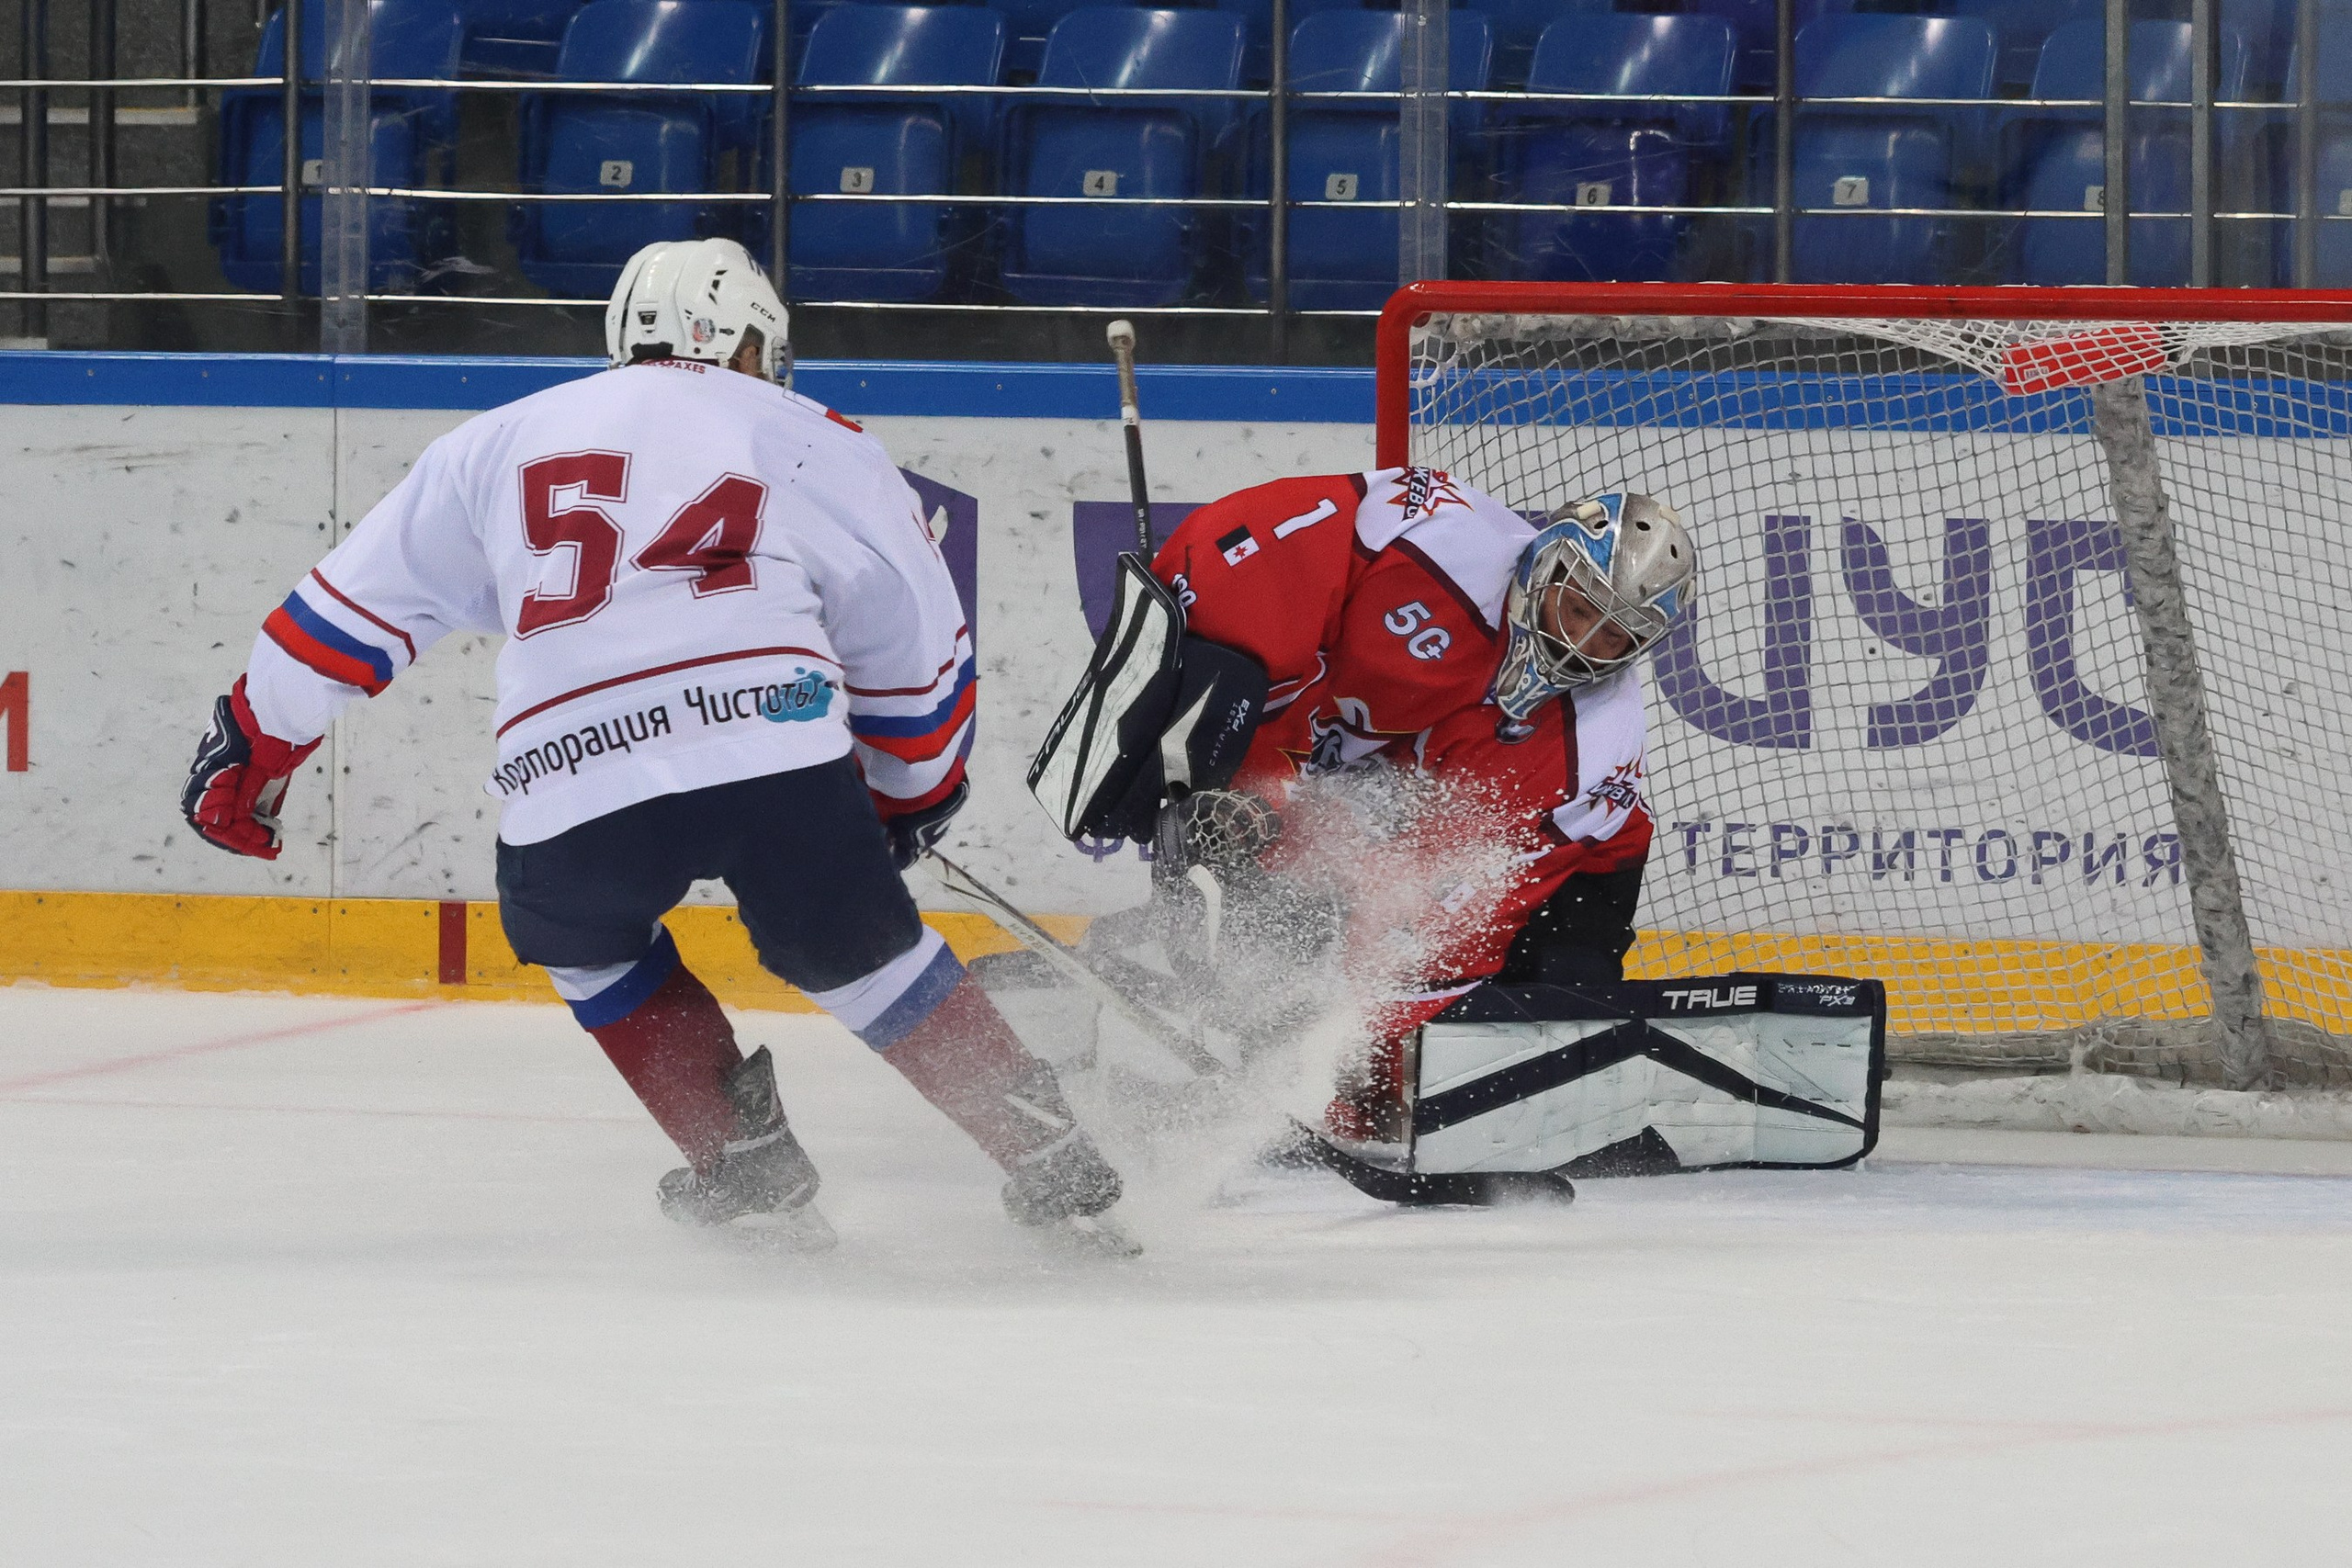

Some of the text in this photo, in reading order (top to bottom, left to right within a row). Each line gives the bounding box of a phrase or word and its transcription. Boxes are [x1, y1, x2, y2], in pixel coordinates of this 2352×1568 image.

[611, 165, 623, 181] 2
[851, 171, 863, 188] 3
[1093, 175, 1105, 191] 4
[1335, 179, 1348, 196] 5
[1587, 186, 1598, 205] 6
[1846, 183, 1858, 199] 7
[750, 301, 776, 323] CCM
[1272, 497, 1338, 540] 1
[514, 447, 769, 641] 54
[1231, 698, 1250, 732] PX3
[492, 680, 820, 795] Корпорация Чистоты
[1672, 821, 2180, 887] ТЕРРИТОРИЯ
[1662, 985, 1758, 1010] TRUE
